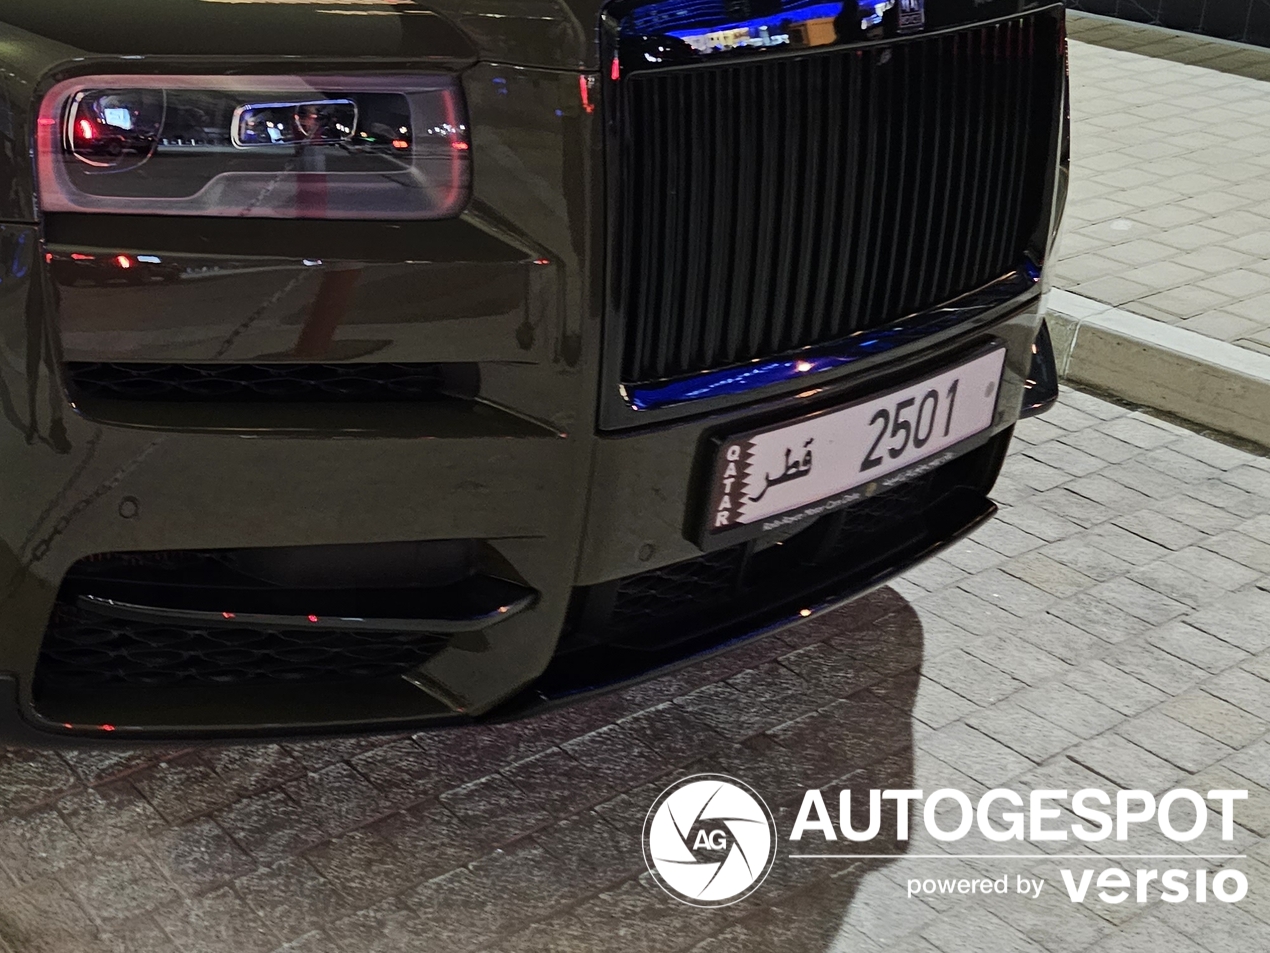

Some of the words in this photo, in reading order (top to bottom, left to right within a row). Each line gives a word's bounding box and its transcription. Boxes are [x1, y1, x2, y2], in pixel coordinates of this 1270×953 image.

[859, 378, 960, 473] 2501
[715, 445, 741, 527] QATAR
[748, 438, 814, 502] قطر
